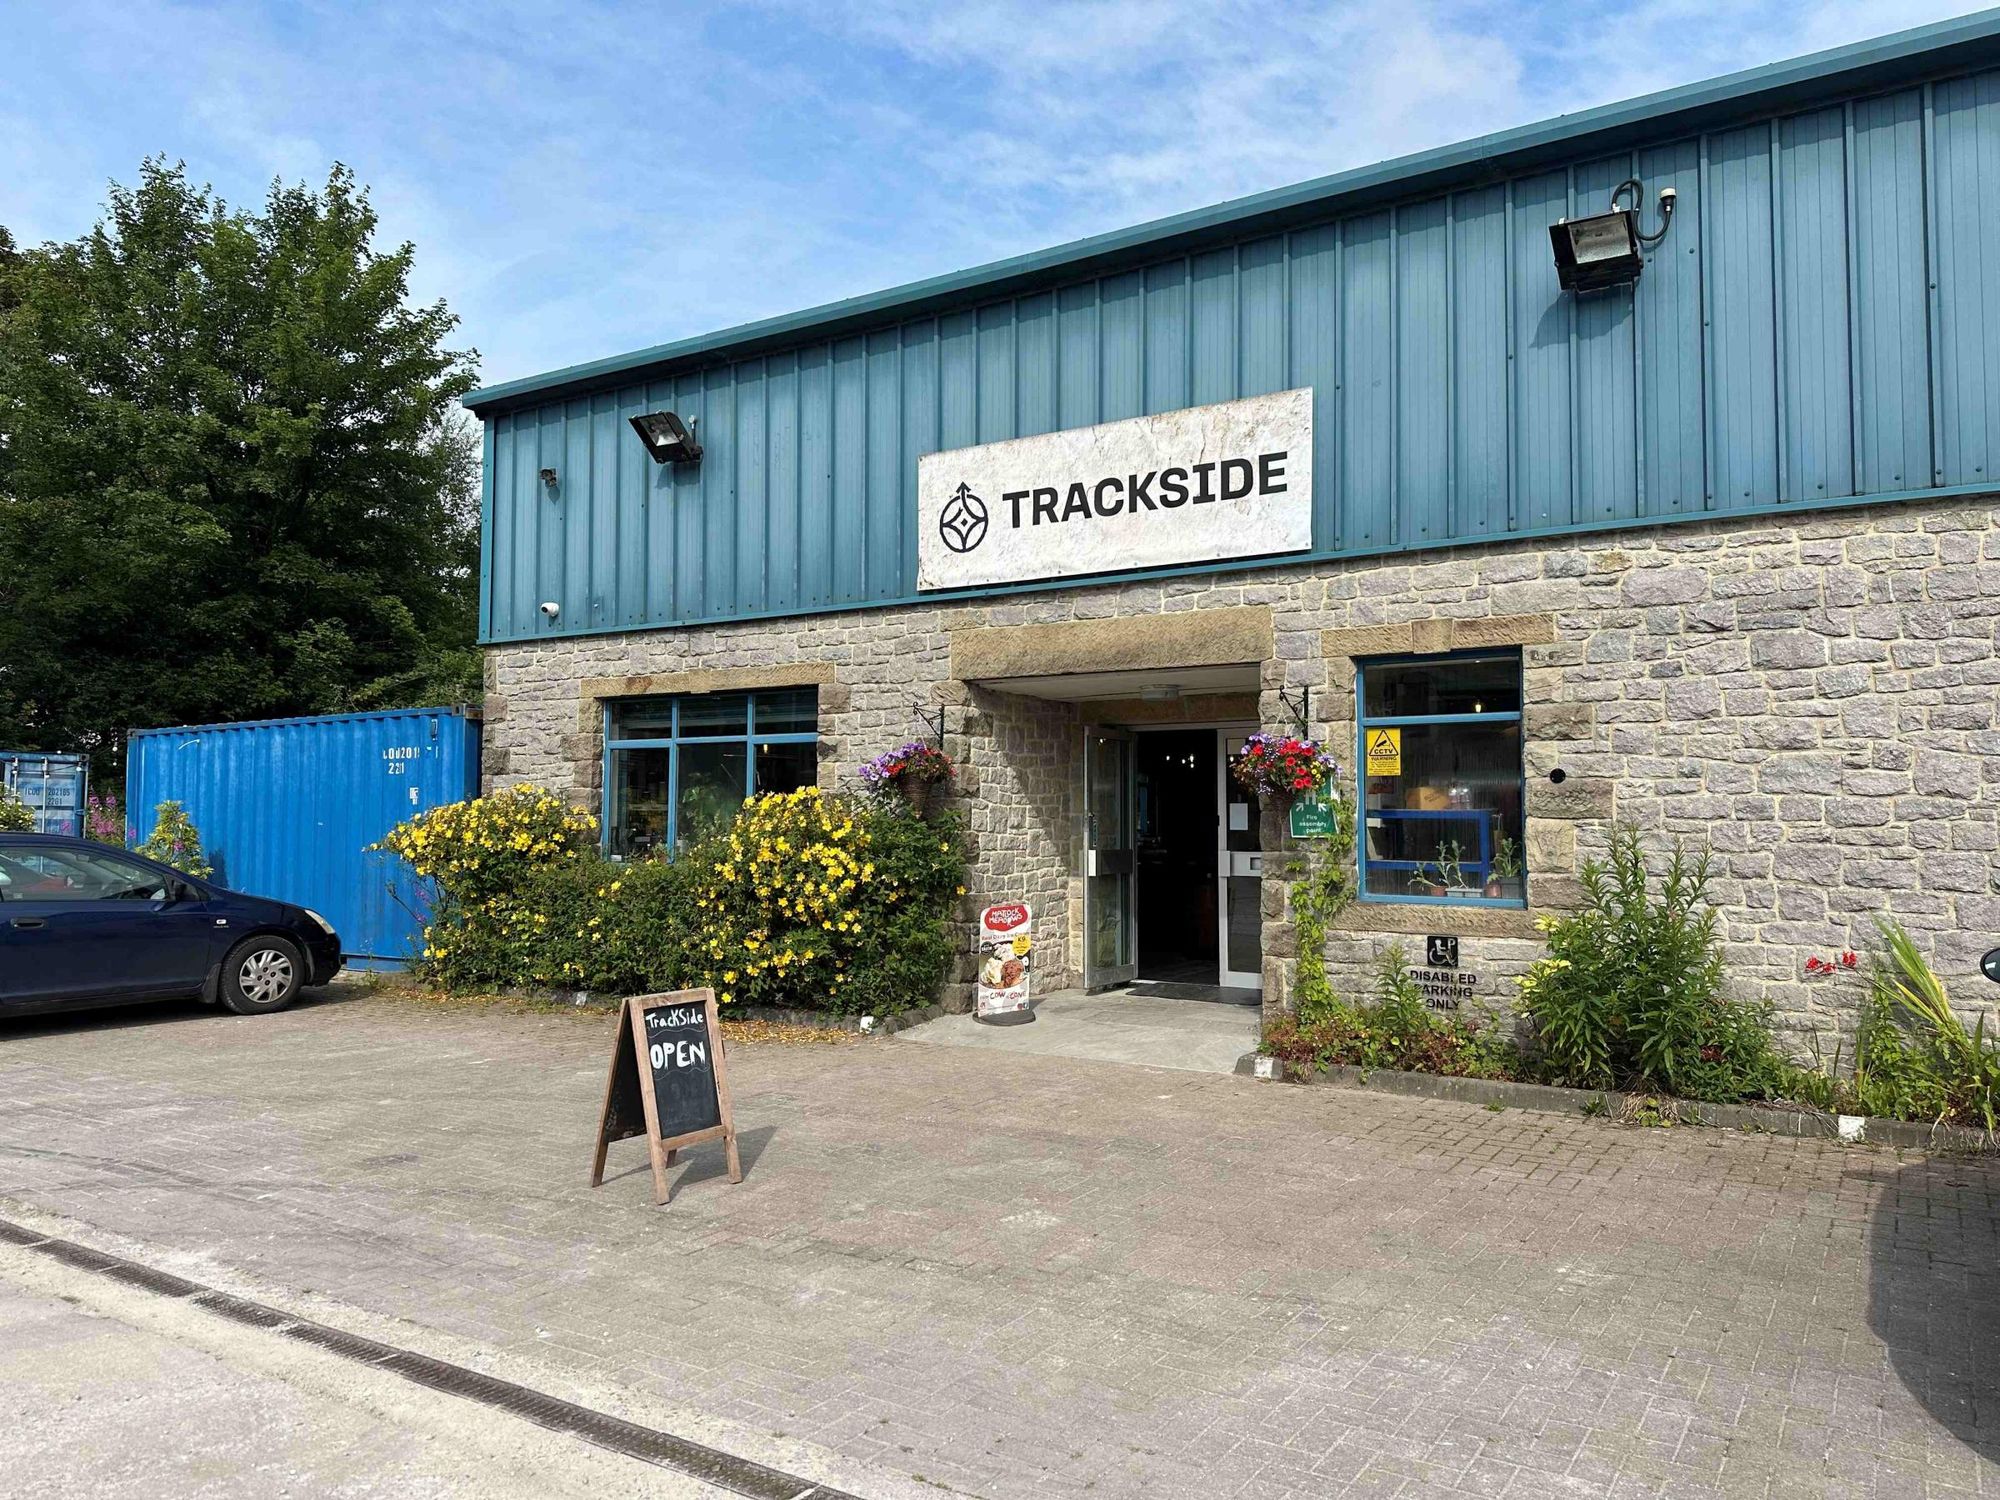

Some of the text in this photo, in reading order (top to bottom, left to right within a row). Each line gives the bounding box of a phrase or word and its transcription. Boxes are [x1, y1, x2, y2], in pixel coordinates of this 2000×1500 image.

[1002, 451, 1288, 529] TRACKSIDE
[1426, 998, 1461, 1010] ONLY
[650, 1040, 706, 1070] OPEN
